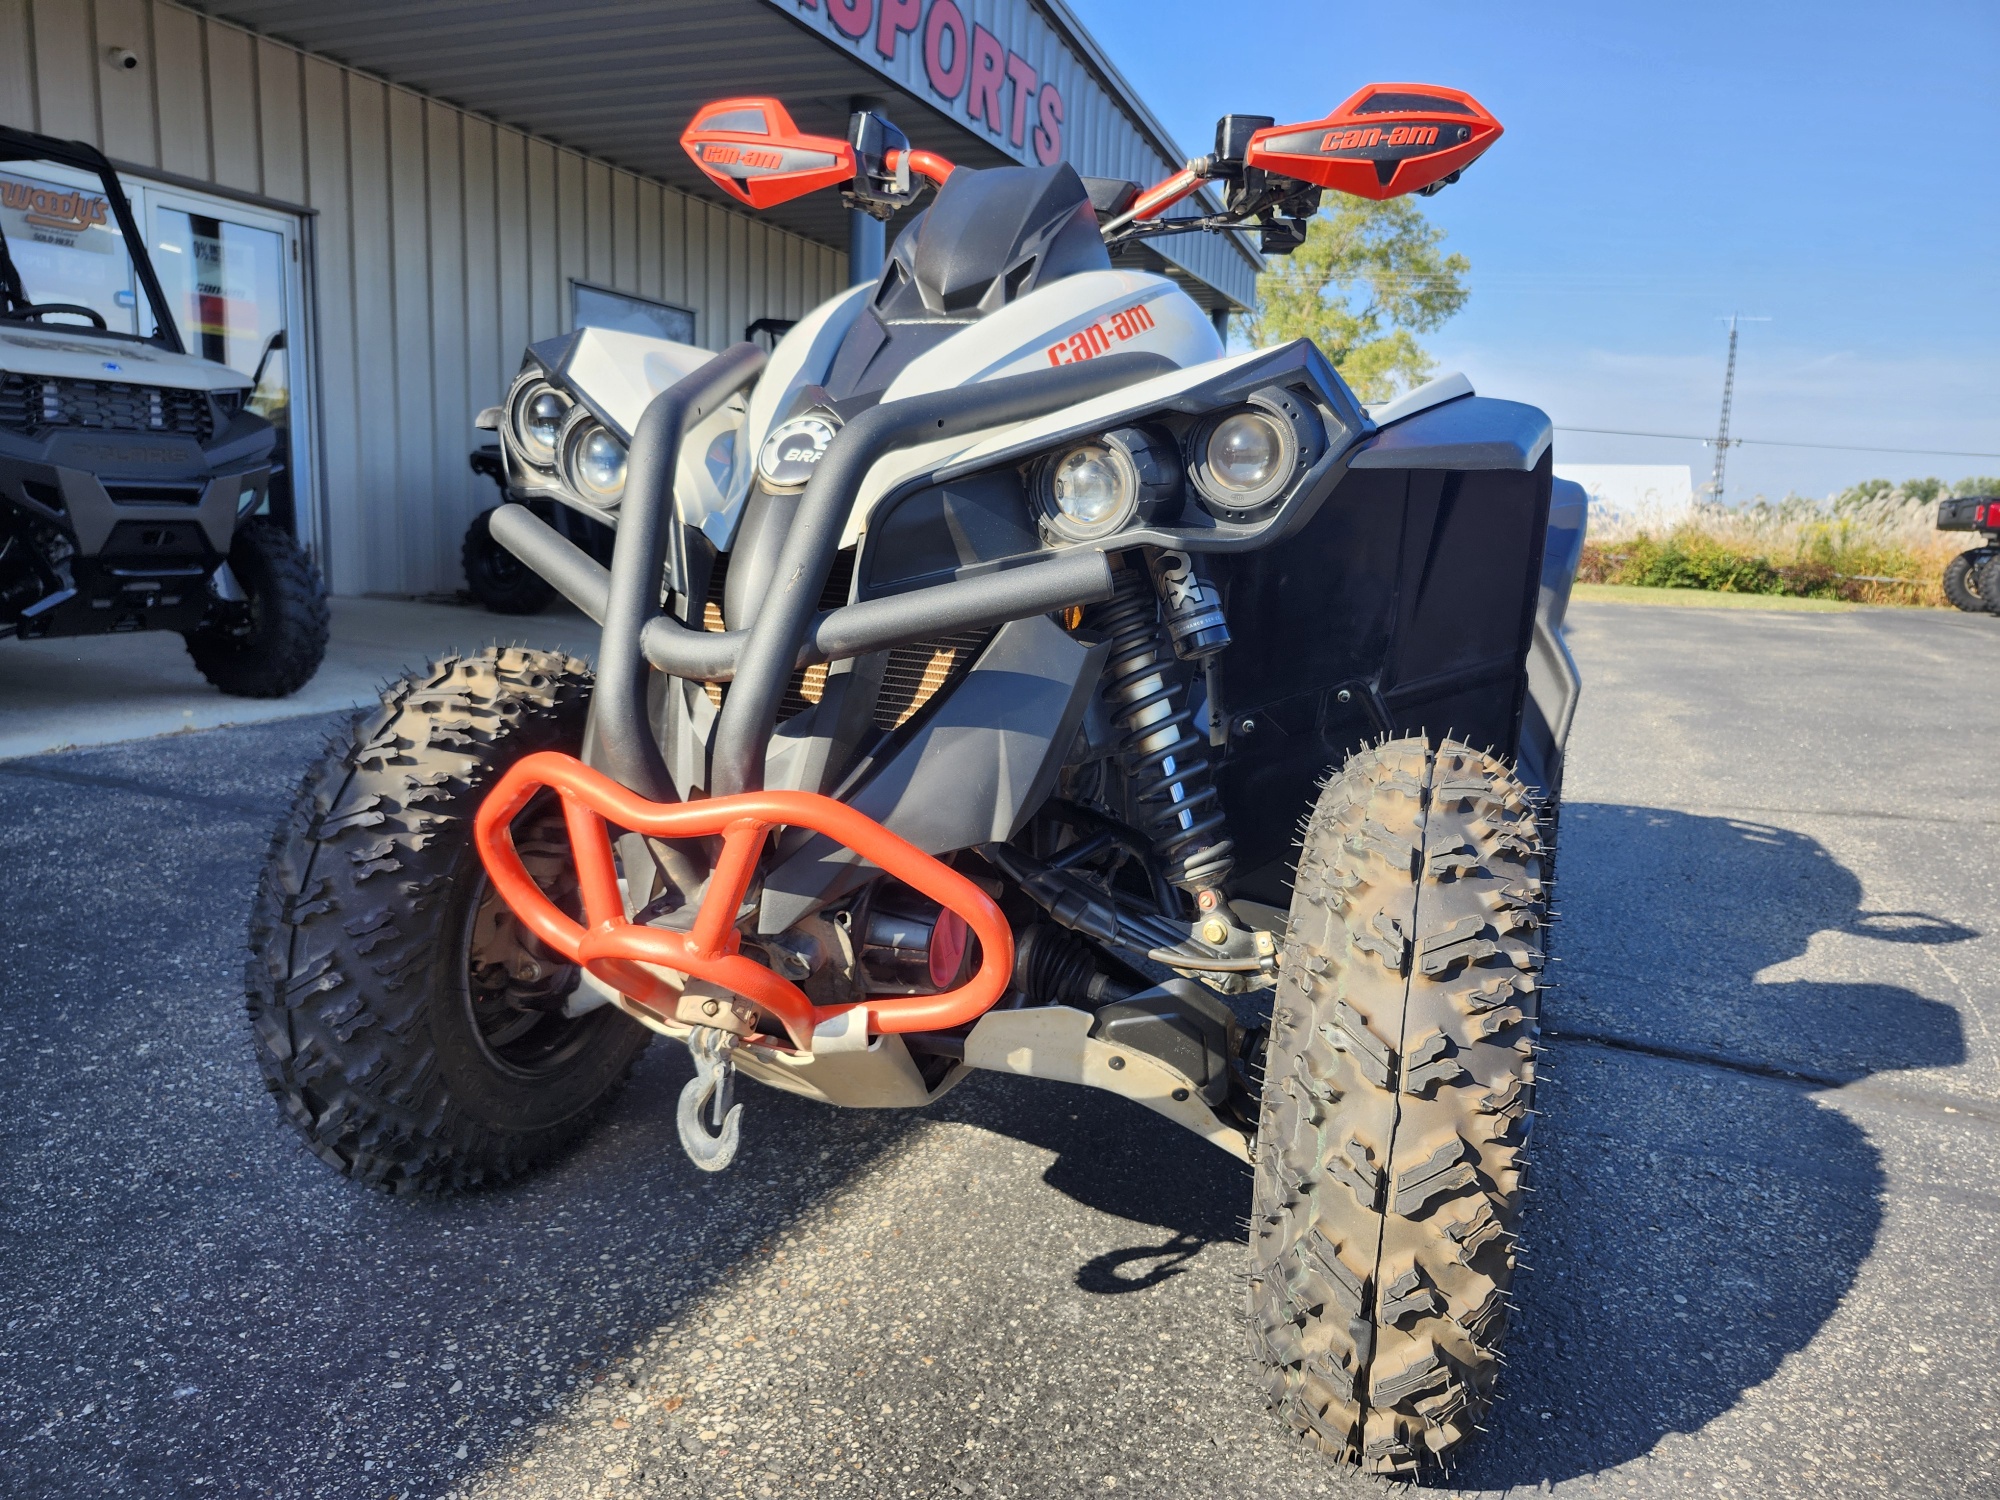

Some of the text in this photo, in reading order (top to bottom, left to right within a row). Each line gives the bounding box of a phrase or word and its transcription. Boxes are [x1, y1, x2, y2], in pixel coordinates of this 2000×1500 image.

[1320, 126, 1439, 152] can-am
[702, 144, 784, 170] can-am
[1047, 303, 1156, 367] can-am
